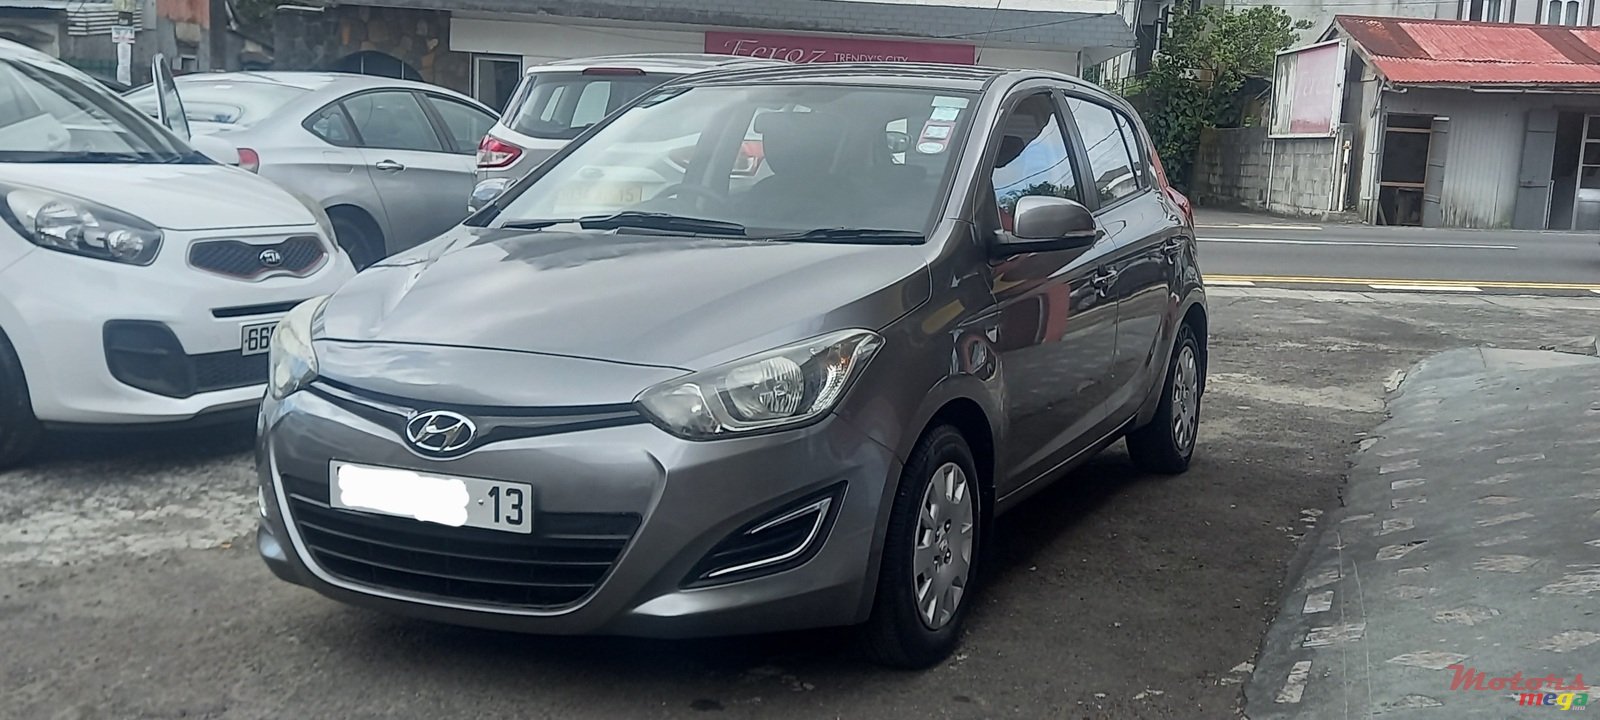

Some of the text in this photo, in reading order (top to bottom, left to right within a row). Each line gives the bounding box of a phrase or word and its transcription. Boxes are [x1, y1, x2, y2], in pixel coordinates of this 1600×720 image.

[834, 53, 882, 62] TRENDY'S
[248, 326, 276, 351] 66
[488, 486, 523, 525] 13
